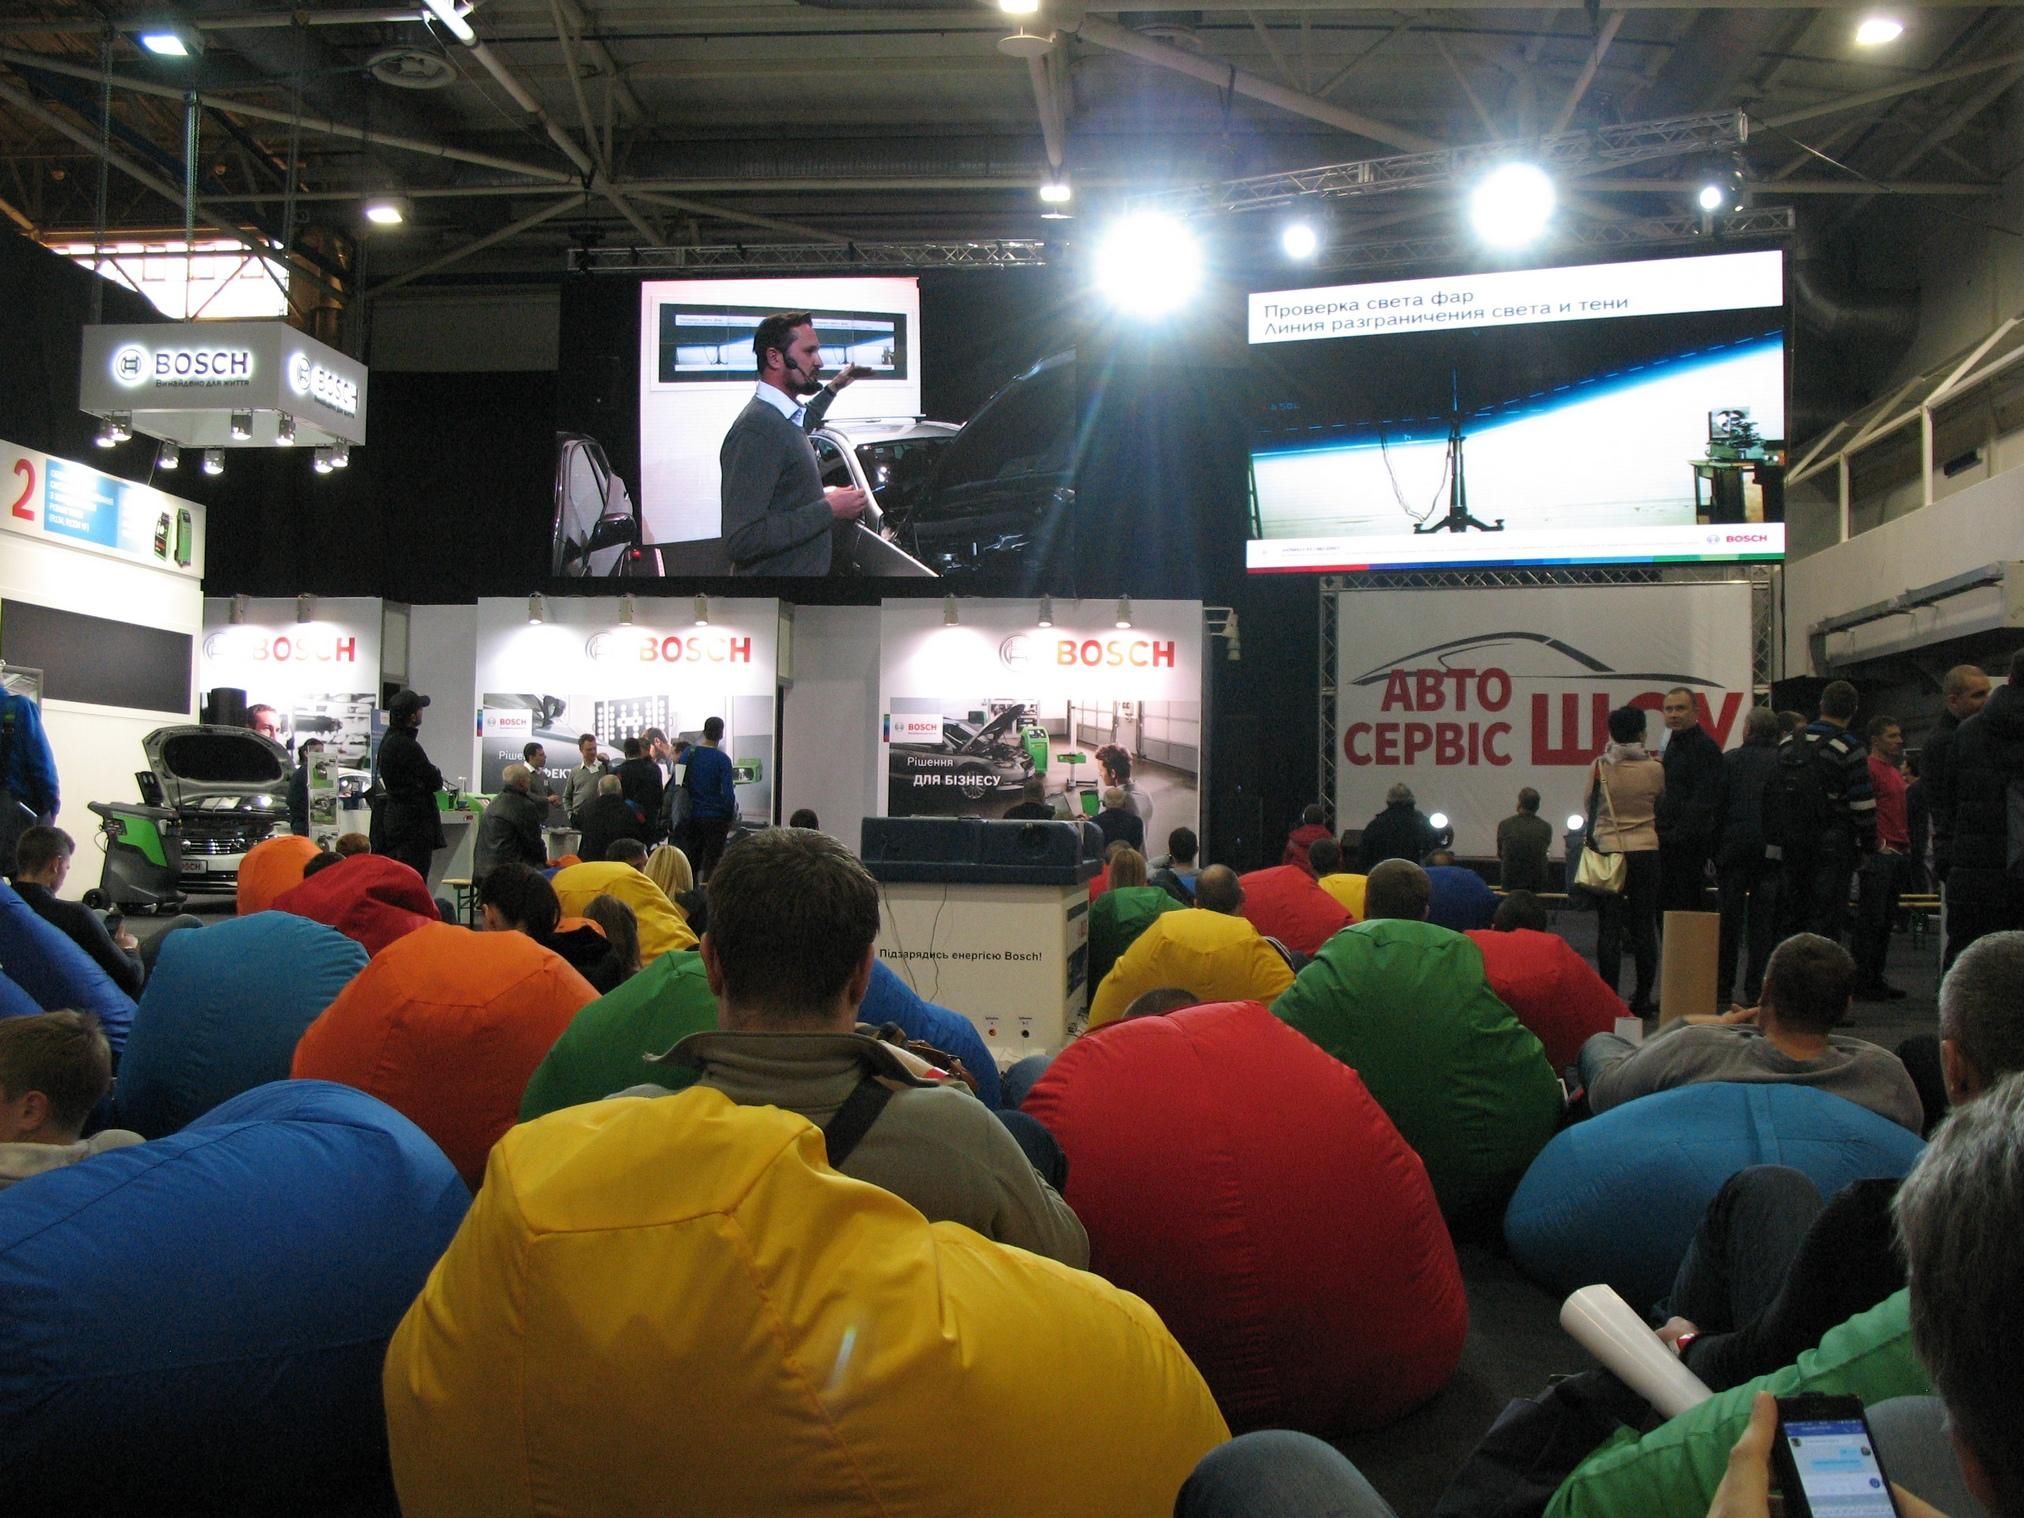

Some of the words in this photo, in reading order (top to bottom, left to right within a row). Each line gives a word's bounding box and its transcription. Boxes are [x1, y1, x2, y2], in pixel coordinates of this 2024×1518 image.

[1264, 301, 1359, 319] Проверка
[1367, 295, 1423, 311] света
[1431, 290, 1474, 306] фар
[1264, 321, 1325, 336] Линия
[1332, 309, 1484, 332] разграничения
[1492, 304, 1551, 318] света
[1559, 302, 1571, 313] и
[1579, 298, 1629, 312] тени
[156, 352, 248, 375] BOSCH
[12, 458, 36, 521] 2
[1726, 534, 1767, 543] BOSCH
[640, 636, 751, 663] BOSCH
[1057, 640, 1175, 667] BOSCH
[1381, 667, 1512, 713] АВТО
[499, 718, 527, 726] BOSCH
[907, 723, 937, 732] BOSCH
[1343, 721, 1513, 767] СЕРВІС
[907, 756, 954, 767] Рішення
[913, 775, 941, 787] ДЛЯ
[945, 775, 1001, 787] БІЗНЕСУ
[879, 949, 949, 962] Підзарядись
[1004, 951, 1042, 962] Bosch!
